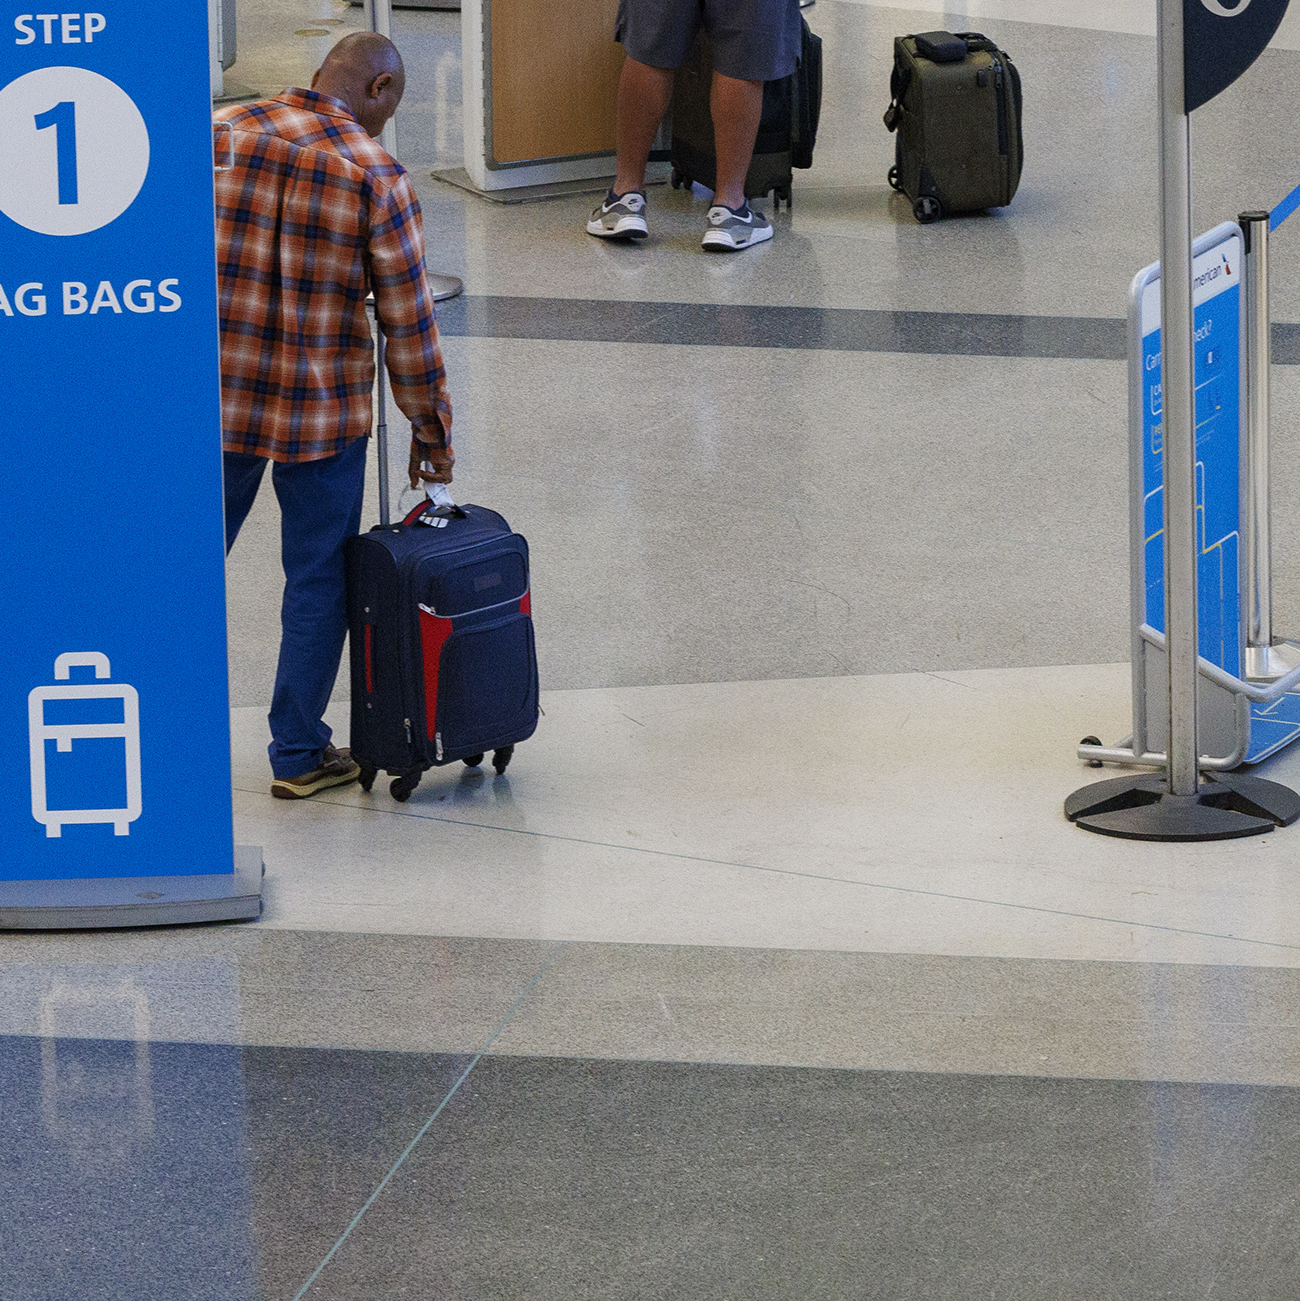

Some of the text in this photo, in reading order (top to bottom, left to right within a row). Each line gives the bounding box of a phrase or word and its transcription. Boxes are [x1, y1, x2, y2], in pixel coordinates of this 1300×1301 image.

[13, 13, 107, 46] STEP
[33, 101, 79, 205] 1
[1194, 264, 1222, 289] merican
[62, 278, 182, 316] BAGS
